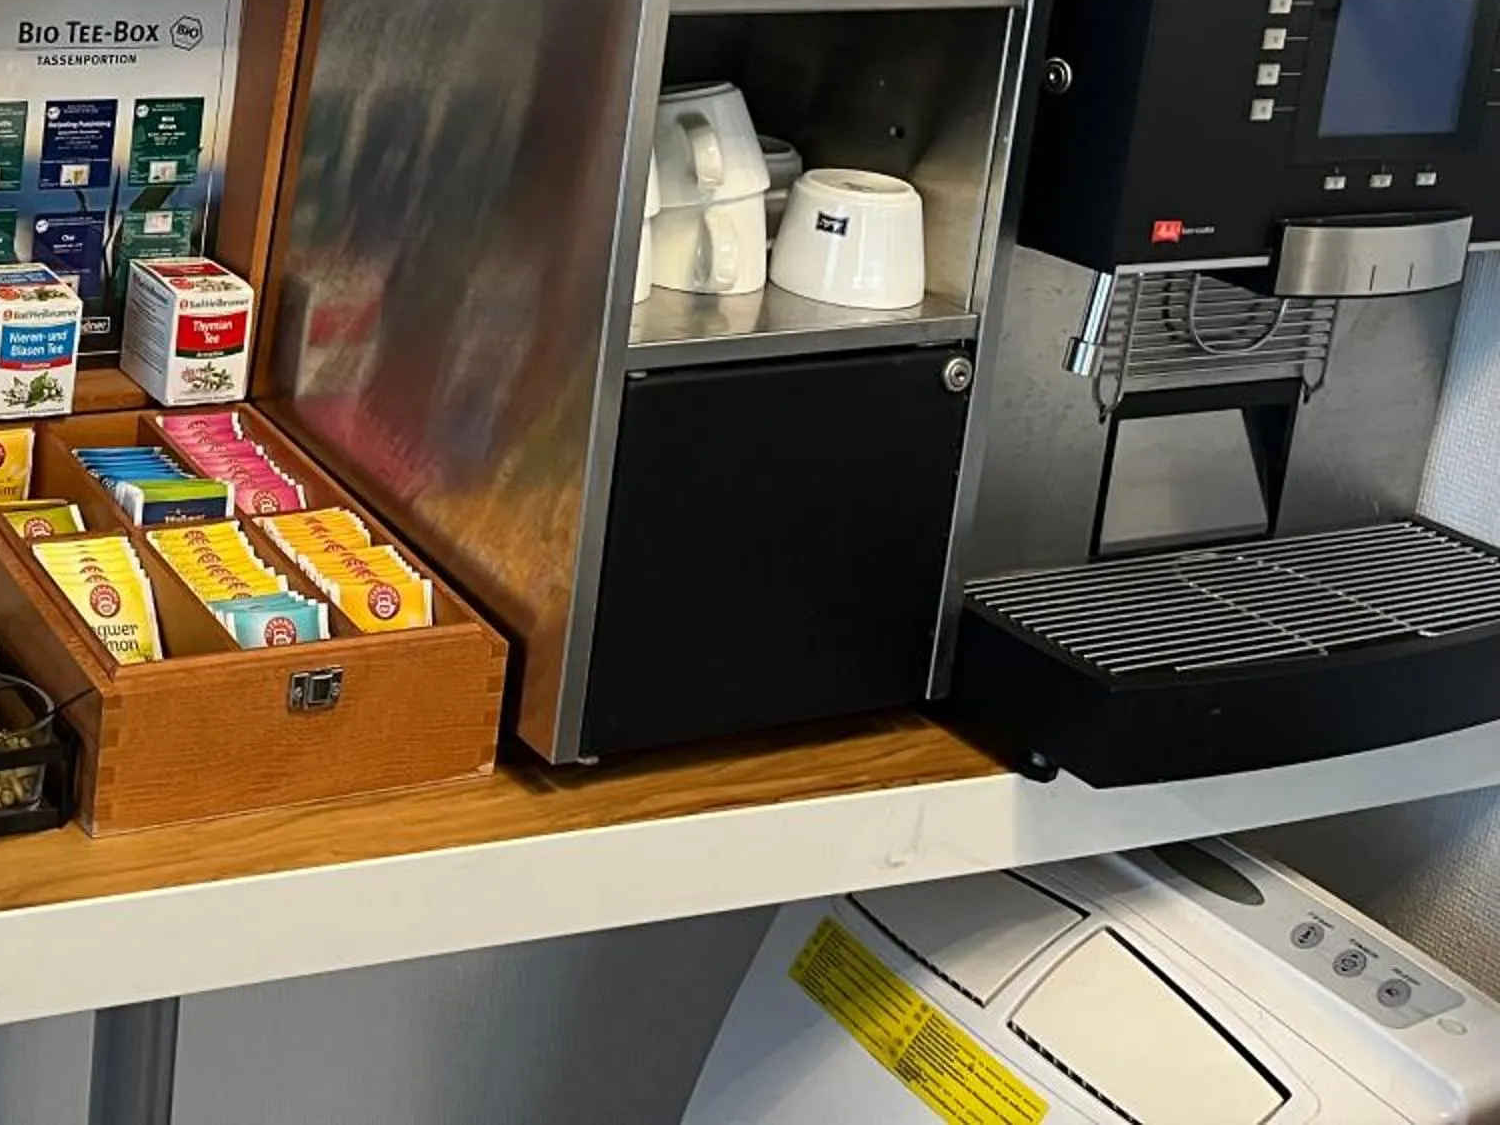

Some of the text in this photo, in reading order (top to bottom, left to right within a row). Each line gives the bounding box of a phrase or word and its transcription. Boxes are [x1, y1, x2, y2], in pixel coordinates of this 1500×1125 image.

[36, 53, 138, 66] TASSENPORTION
[192, 320, 233, 333] Thymian
[47, 330, 69, 341] und
[203, 332, 221, 344] Tee
[10, 343, 65, 357] Blasen Tee
